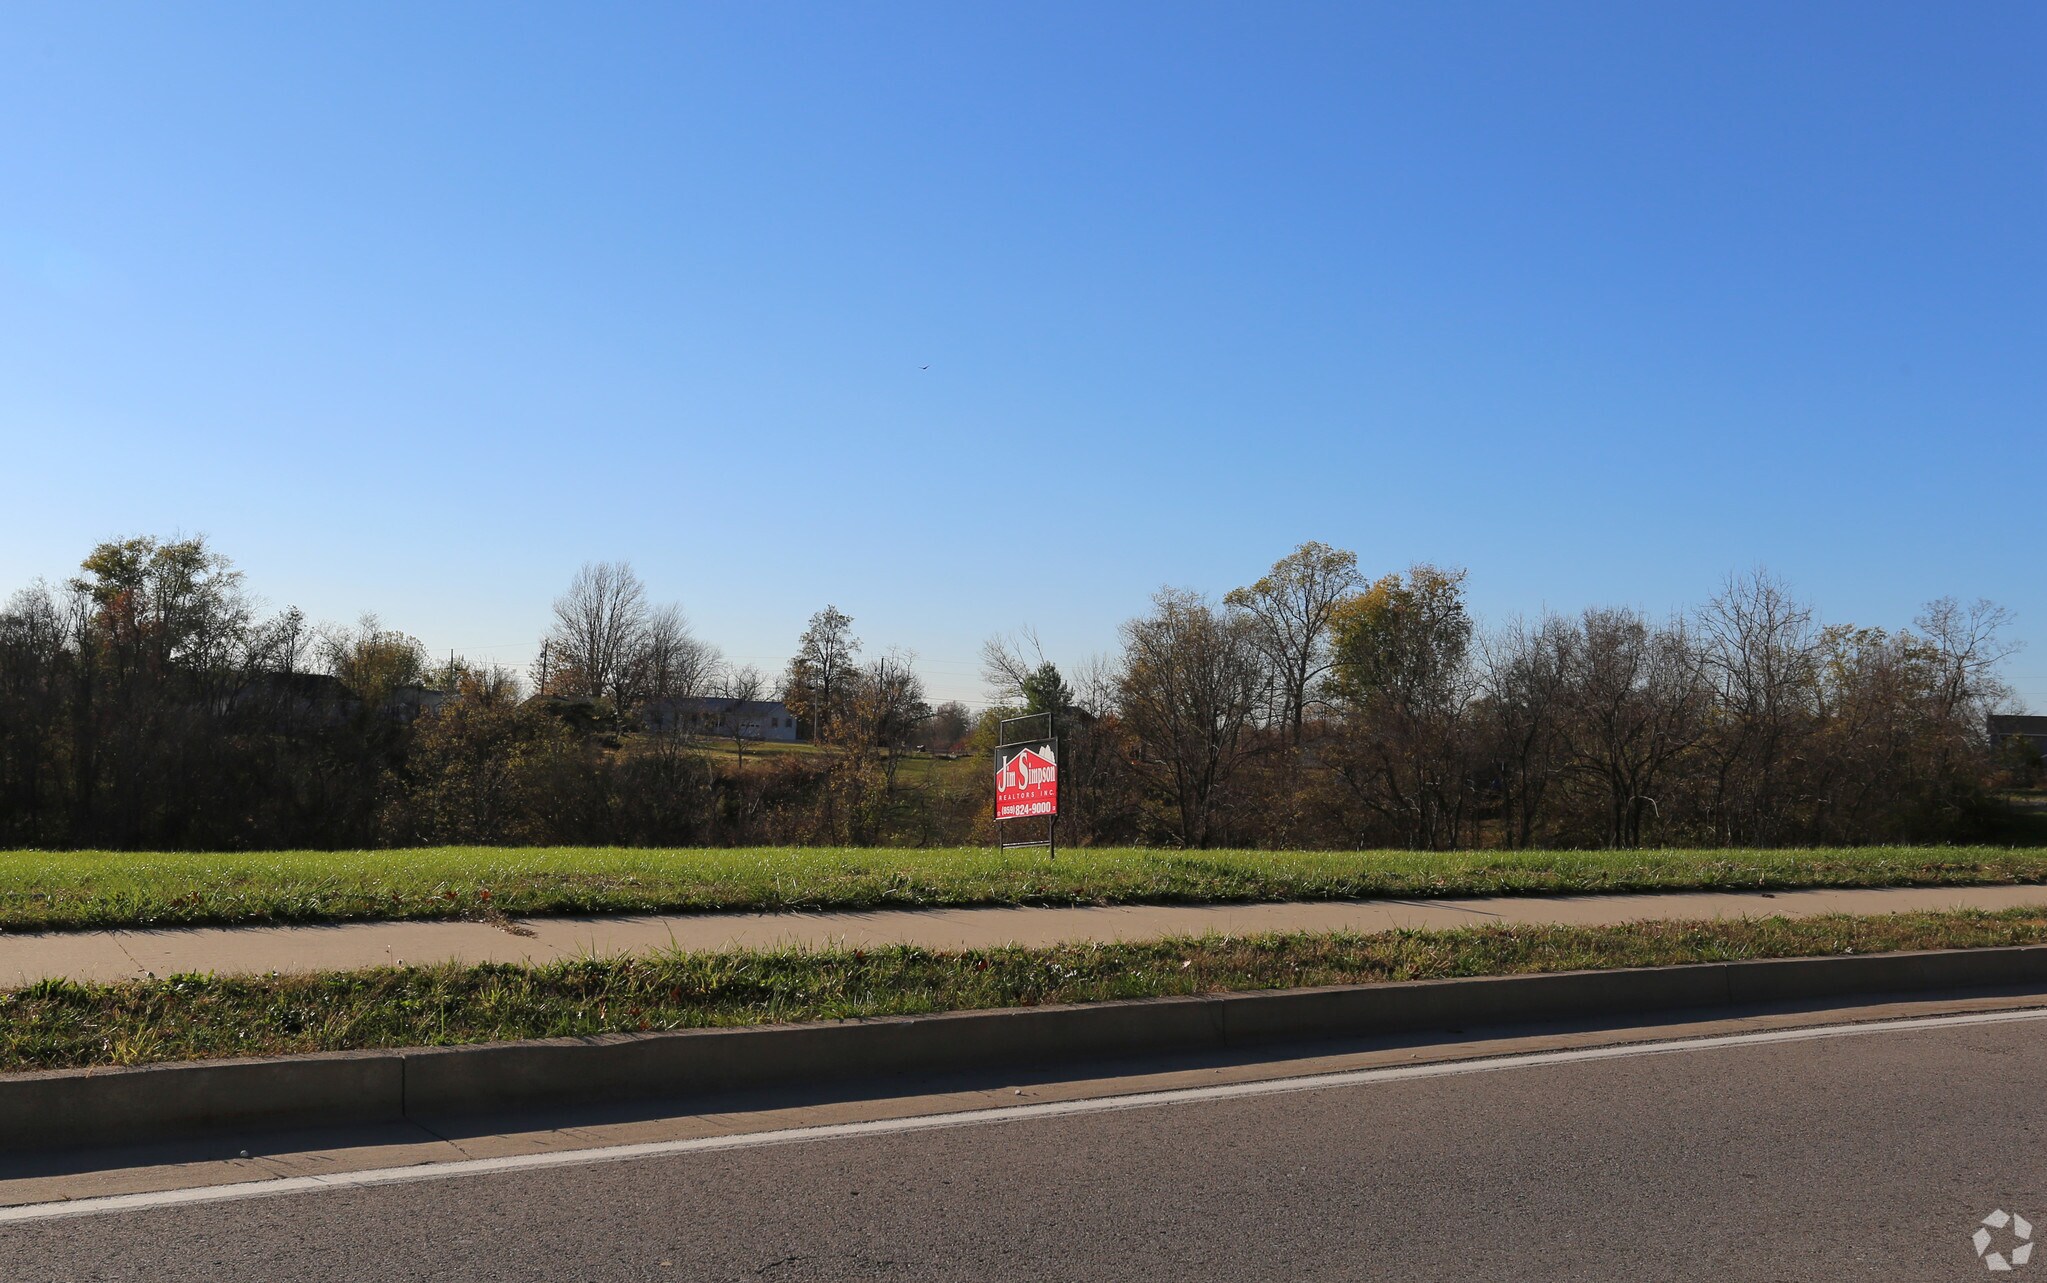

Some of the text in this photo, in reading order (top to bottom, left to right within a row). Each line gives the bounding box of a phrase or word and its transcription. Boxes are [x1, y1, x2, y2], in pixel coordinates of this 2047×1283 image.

[998, 752, 1056, 792] Jim Simpson
[999, 792, 1035, 800] REALTORS
